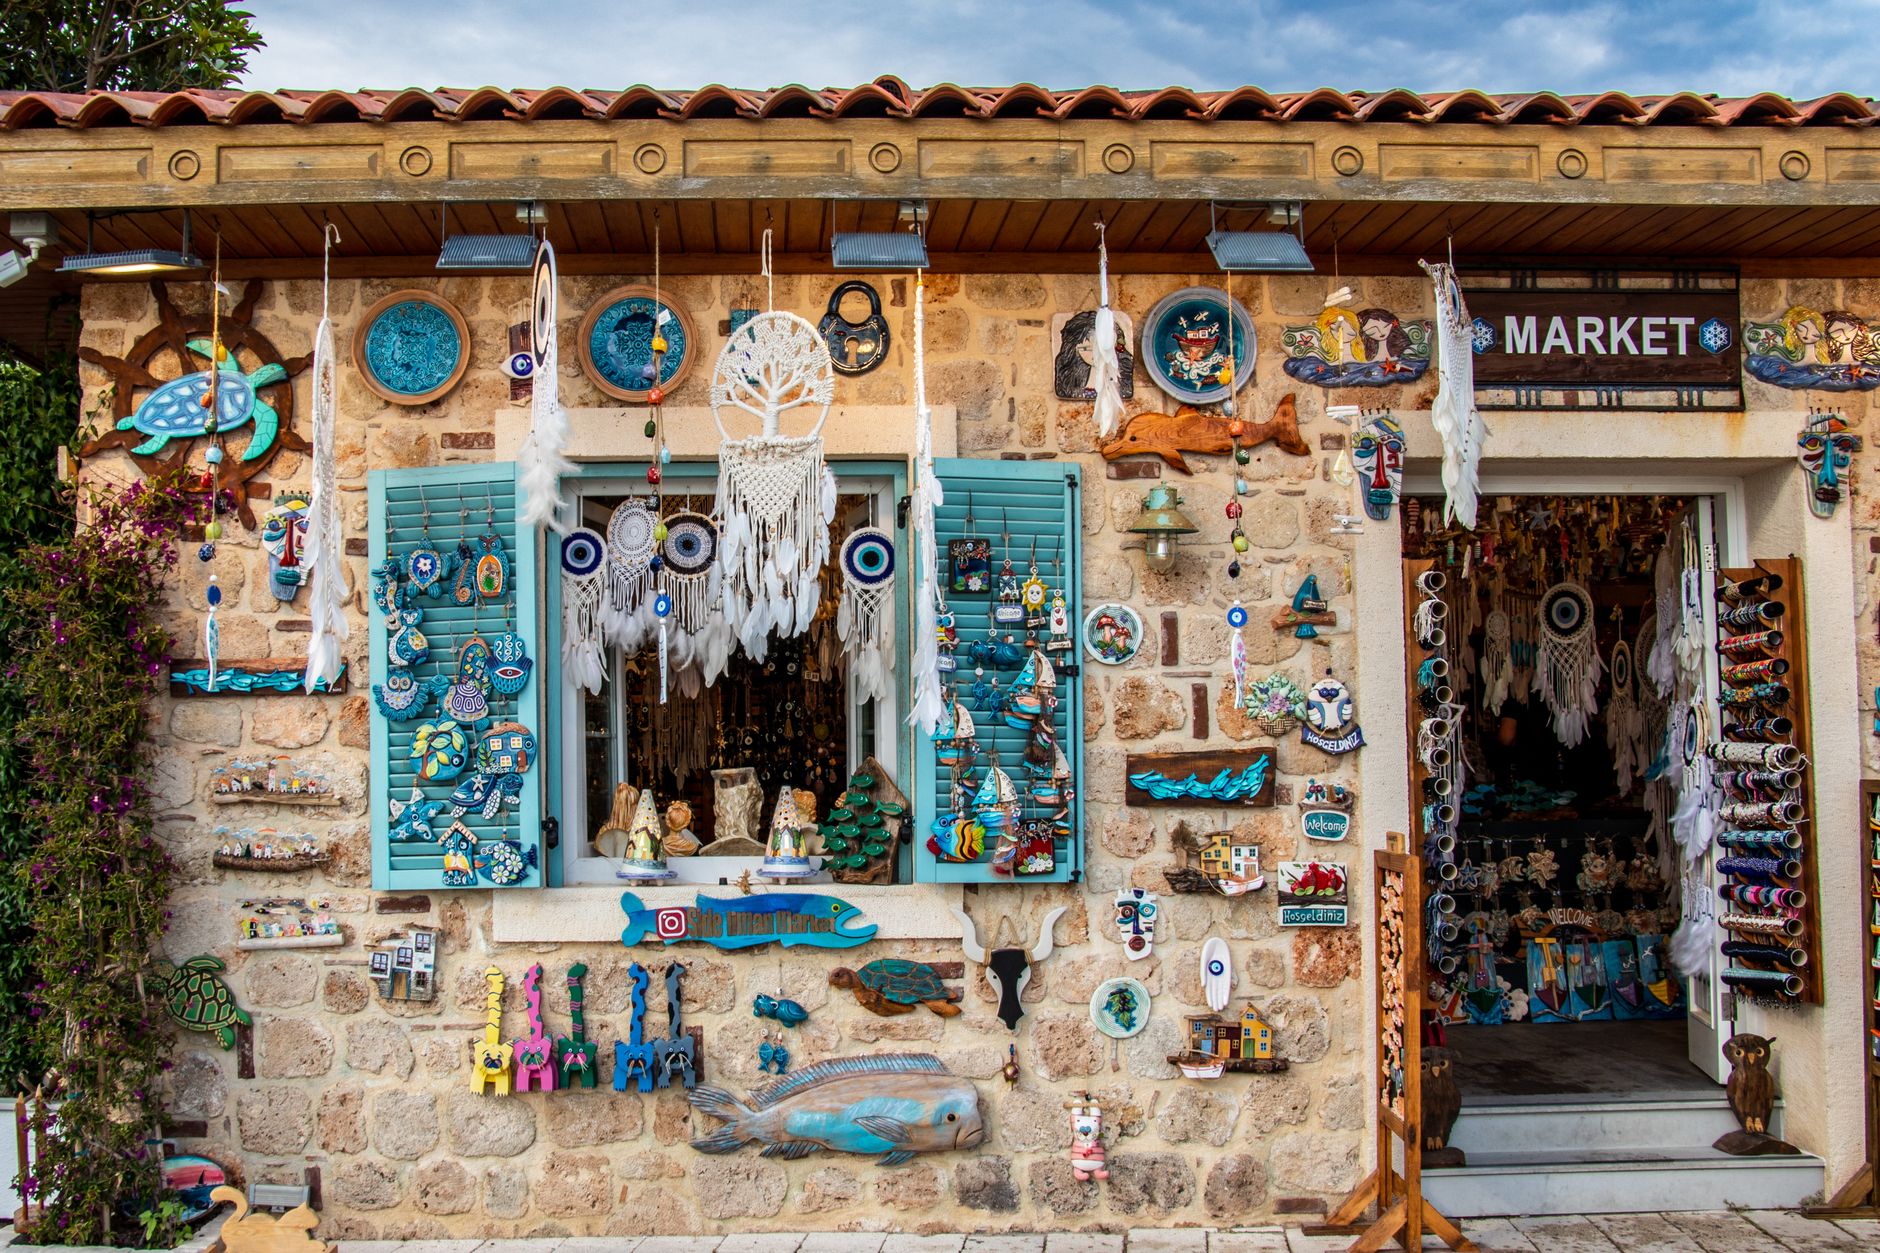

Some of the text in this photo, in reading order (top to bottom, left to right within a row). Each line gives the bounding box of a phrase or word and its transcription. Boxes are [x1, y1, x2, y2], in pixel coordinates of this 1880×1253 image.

[1504, 315, 1695, 355] MARKET
[1305, 816, 1346, 834] Welcome
[686, 907, 722, 938] Side
[1283, 909, 1343, 922] Hosgeldiniz
[1547, 907, 1594, 927] WELCOME
